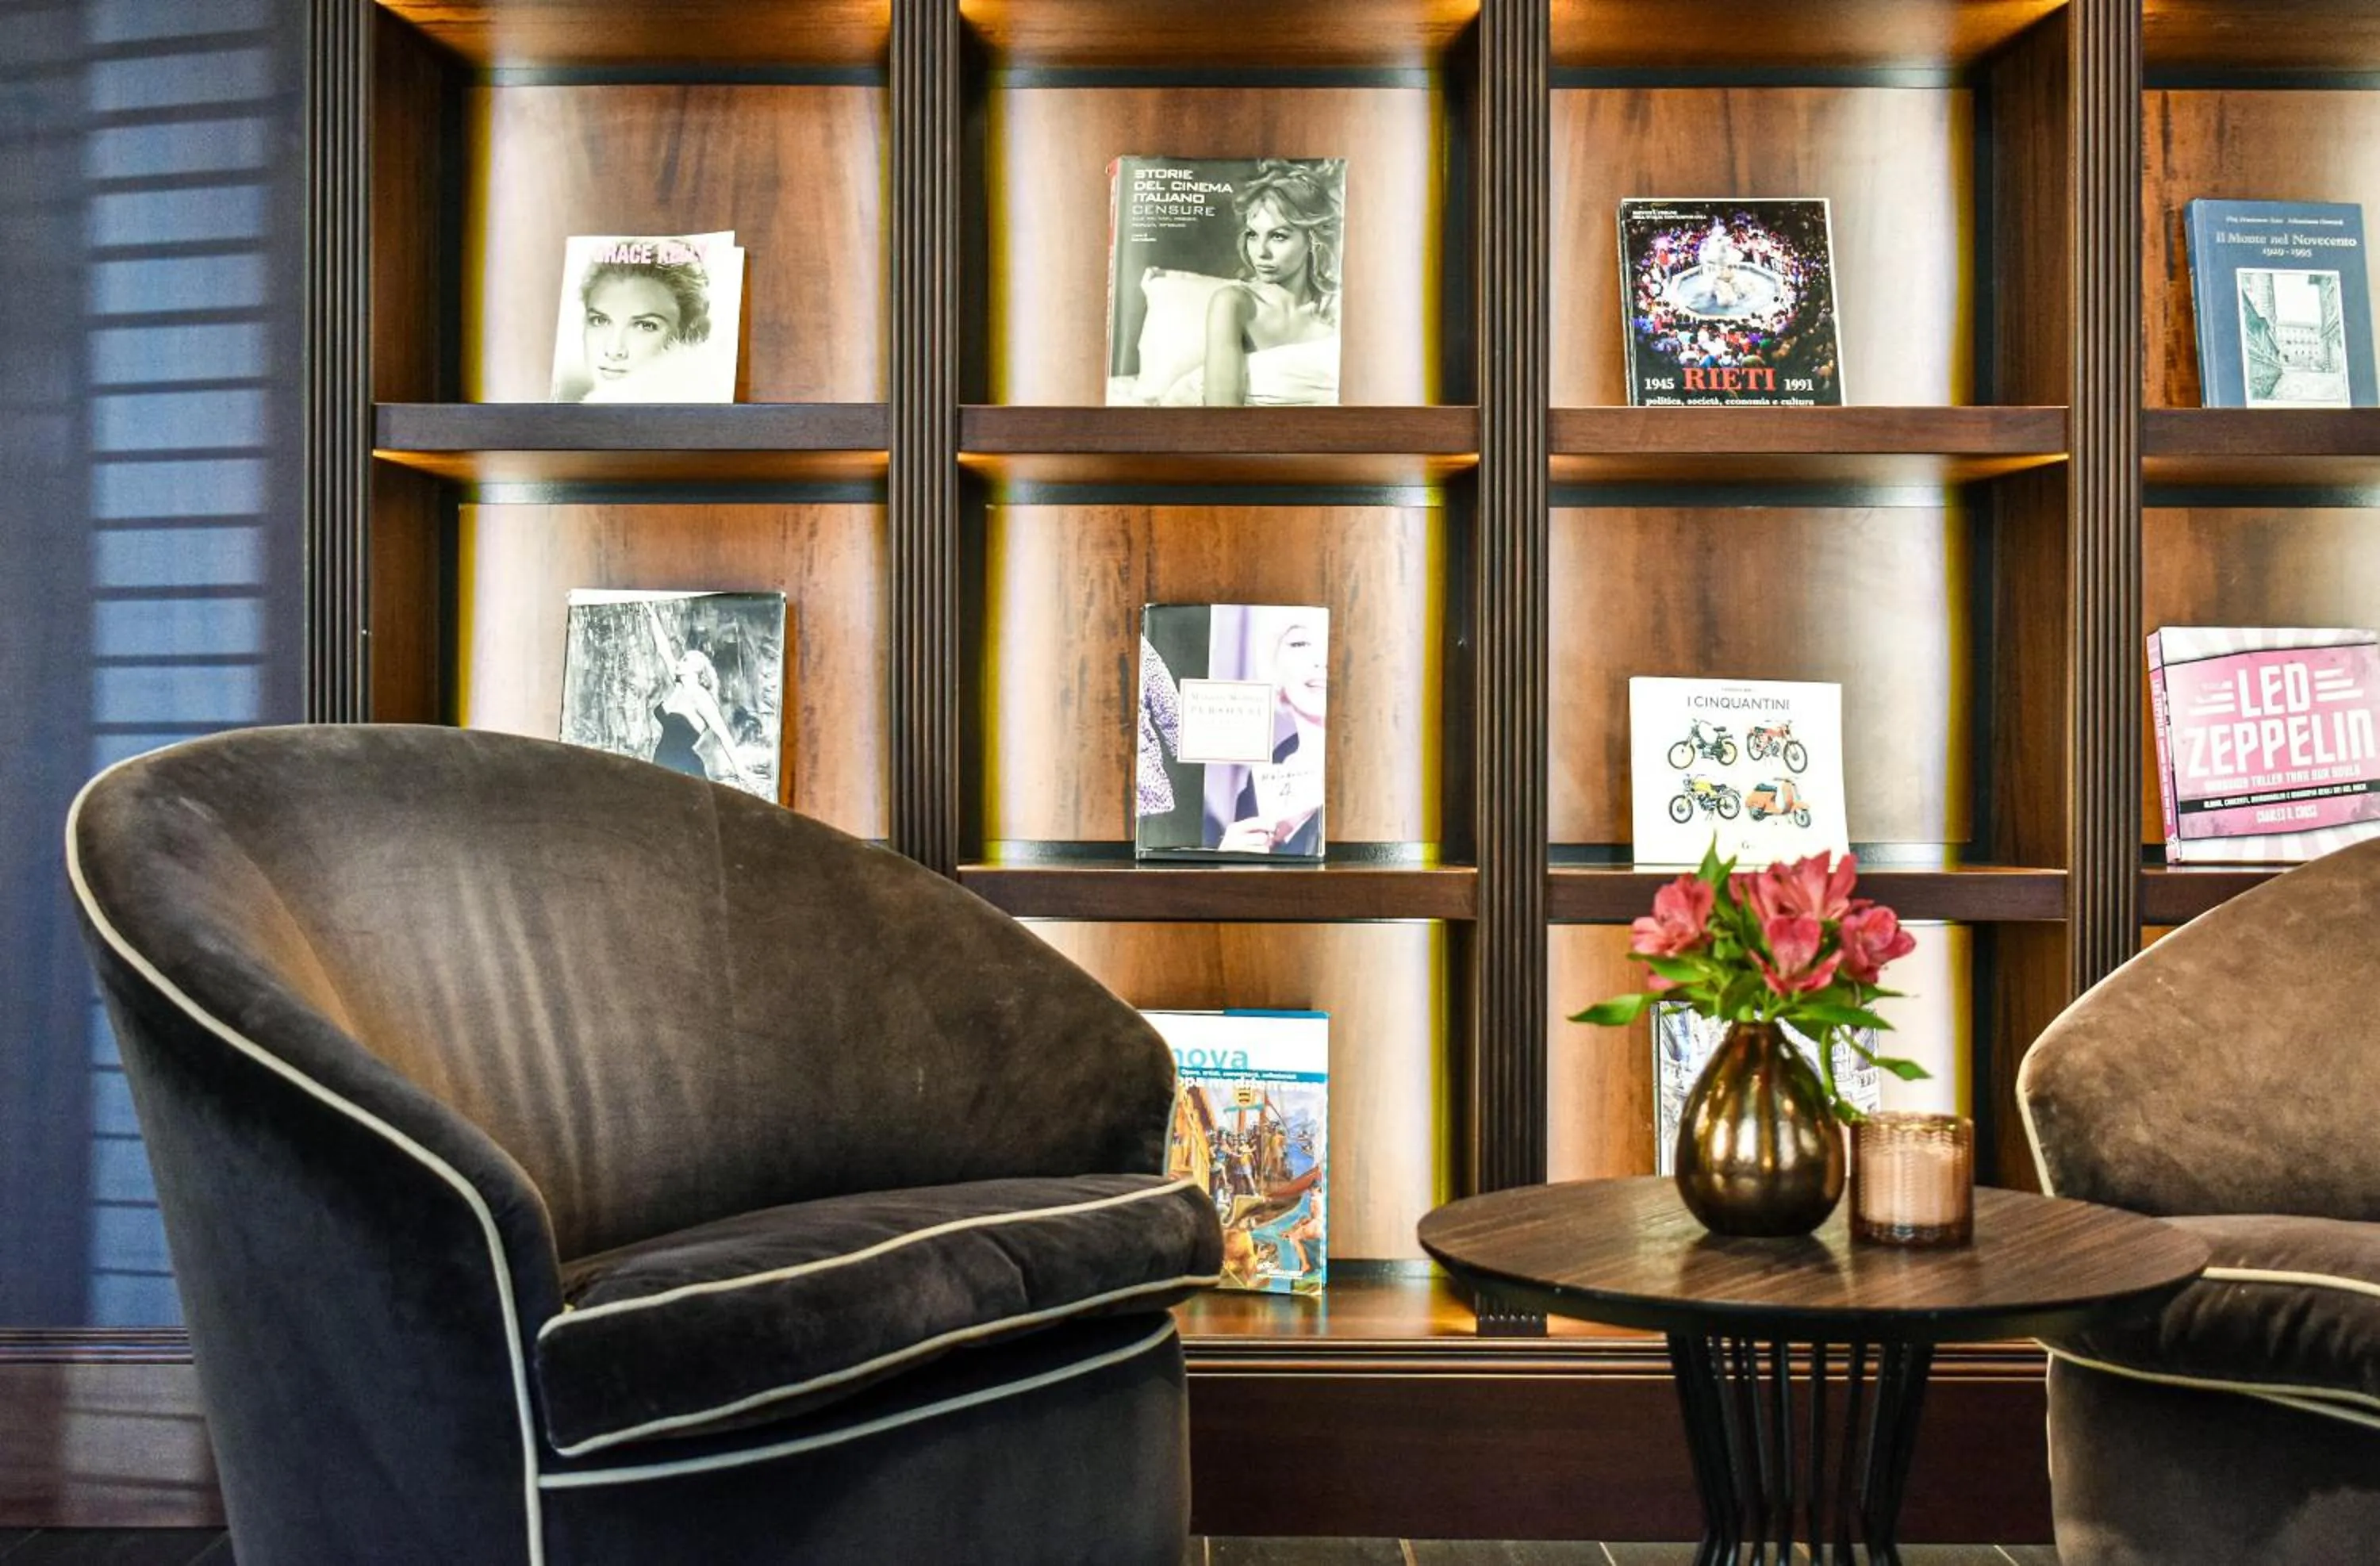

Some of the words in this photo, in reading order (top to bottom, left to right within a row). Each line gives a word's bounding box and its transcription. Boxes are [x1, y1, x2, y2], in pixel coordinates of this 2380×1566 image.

[1134, 169, 1194, 179] STORIE
[1134, 180, 1165, 191] DEL
[1170, 181, 1234, 193] CINEMA
[1133, 193, 1206, 204] ITALIANO
[1132, 205, 1216, 217] CENSURE
[2215, 232, 2225, 243] Il
[2228, 232, 2267, 244] Monte
[2271, 233, 2289, 244] nel
[2292, 234, 2358, 247] Novecento
[593, 243, 651, 263] RACE
[1645, 378, 1675, 390] 1945
[1682, 367, 1777, 391] RIETI
[1783, 378, 1814, 391] 1991
[1645, 396, 1685, 406] politica,
[1724, 397, 1770, 406] economia
[1780, 397, 1814, 406] cultura
[2236, 662, 2311, 719] LED
[1687, 697, 1691, 707] I
[1694, 696, 1790, 709] CINQUANTINI
[2182, 708, 2376, 779] ZEPPELIN
